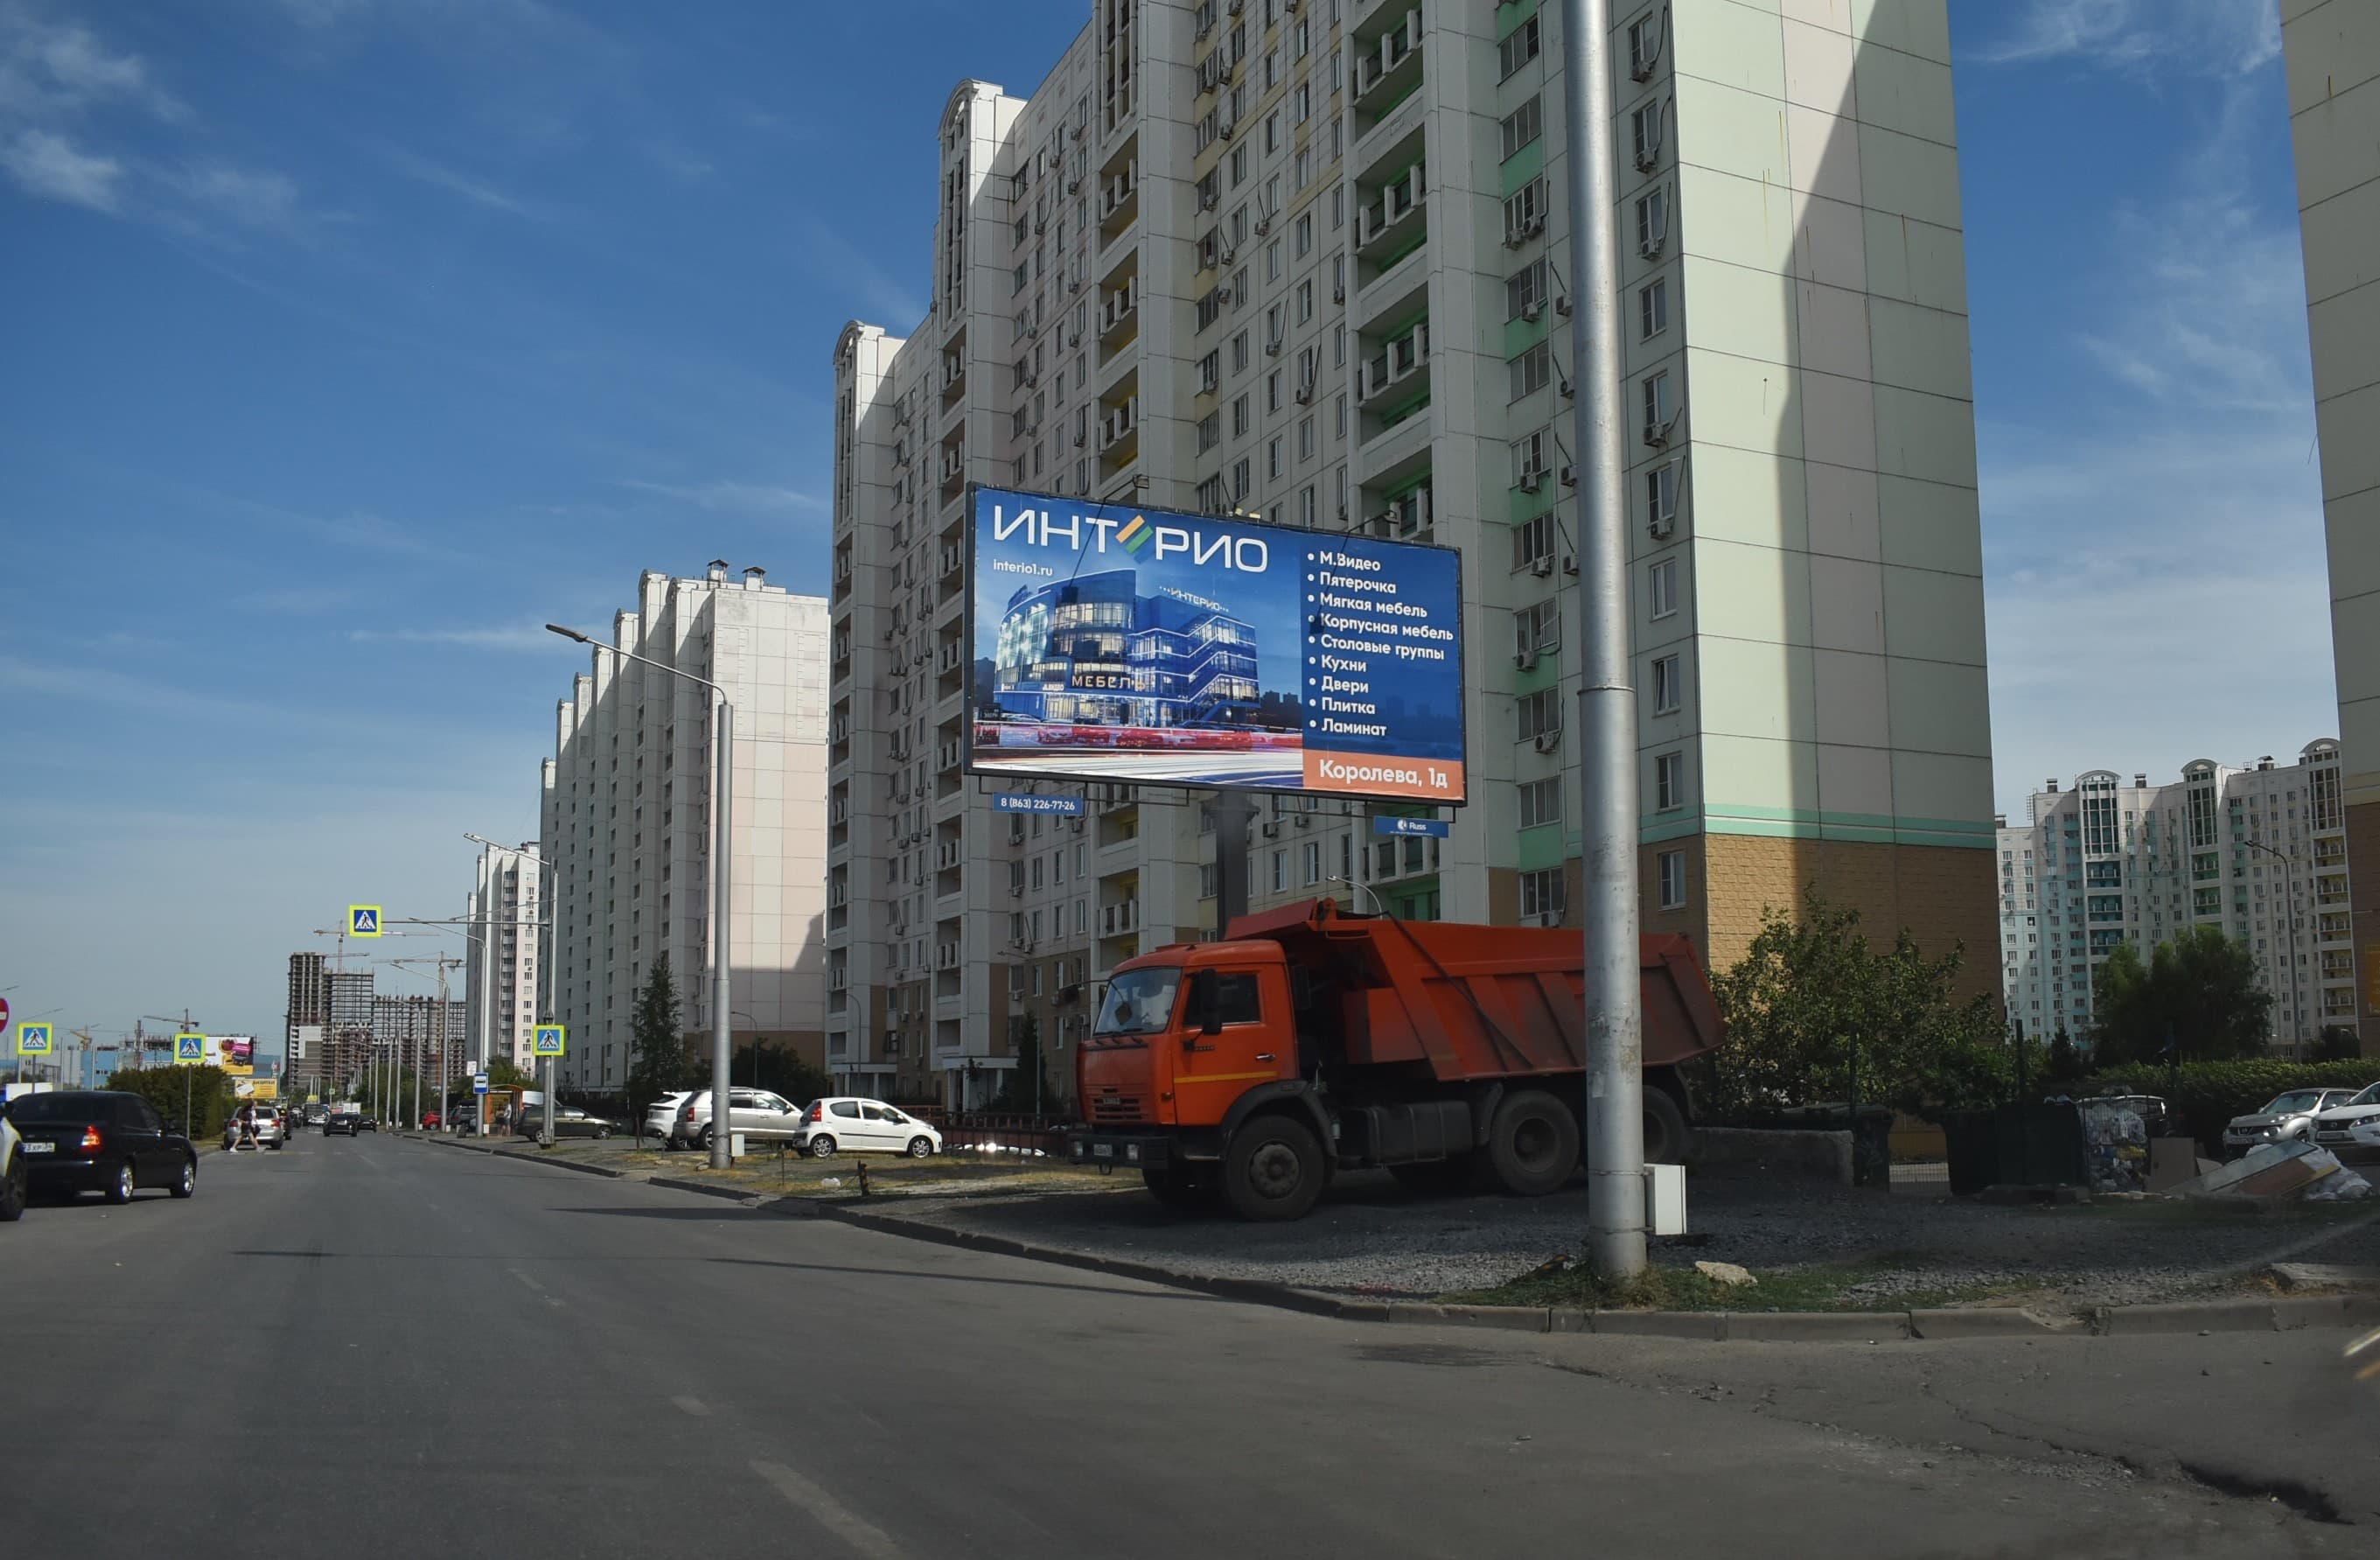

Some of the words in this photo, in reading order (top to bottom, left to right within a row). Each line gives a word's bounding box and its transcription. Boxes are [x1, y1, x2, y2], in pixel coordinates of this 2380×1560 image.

[993, 558, 1053, 577] interio1.ru
[1320, 550, 1381, 571] М.Видео
[1320, 571, 1397, 594] Пятерочка
[1320, 591, 1372, 612] Мягкая
[1376, 602, 1427, 618] мебель
[1320, 612, 1399, 634] Корпусная
[1402, 625, 1454, 640] мебель
[1321, 633, 1392, 654] Столовые
[1395, 645, 1445, 661] группы
[1321, 654, 1367, 673] Кухни
[1321, 675, 1369, 696] Двери
[1322, 696, 1376, 715] Плитка
[1321, 717, 1387, 737] Ламинат
[1319, 759, 1423, 787] Королева,
[1427, 767, 1448, 789] 1д
[1001, 797, 1008, 807] 8
[1009, 797, 1031, 809] (863)
[1033, 799, 1076, 811] 226-77-26
[1408, 821, 1427, 830] Russ
